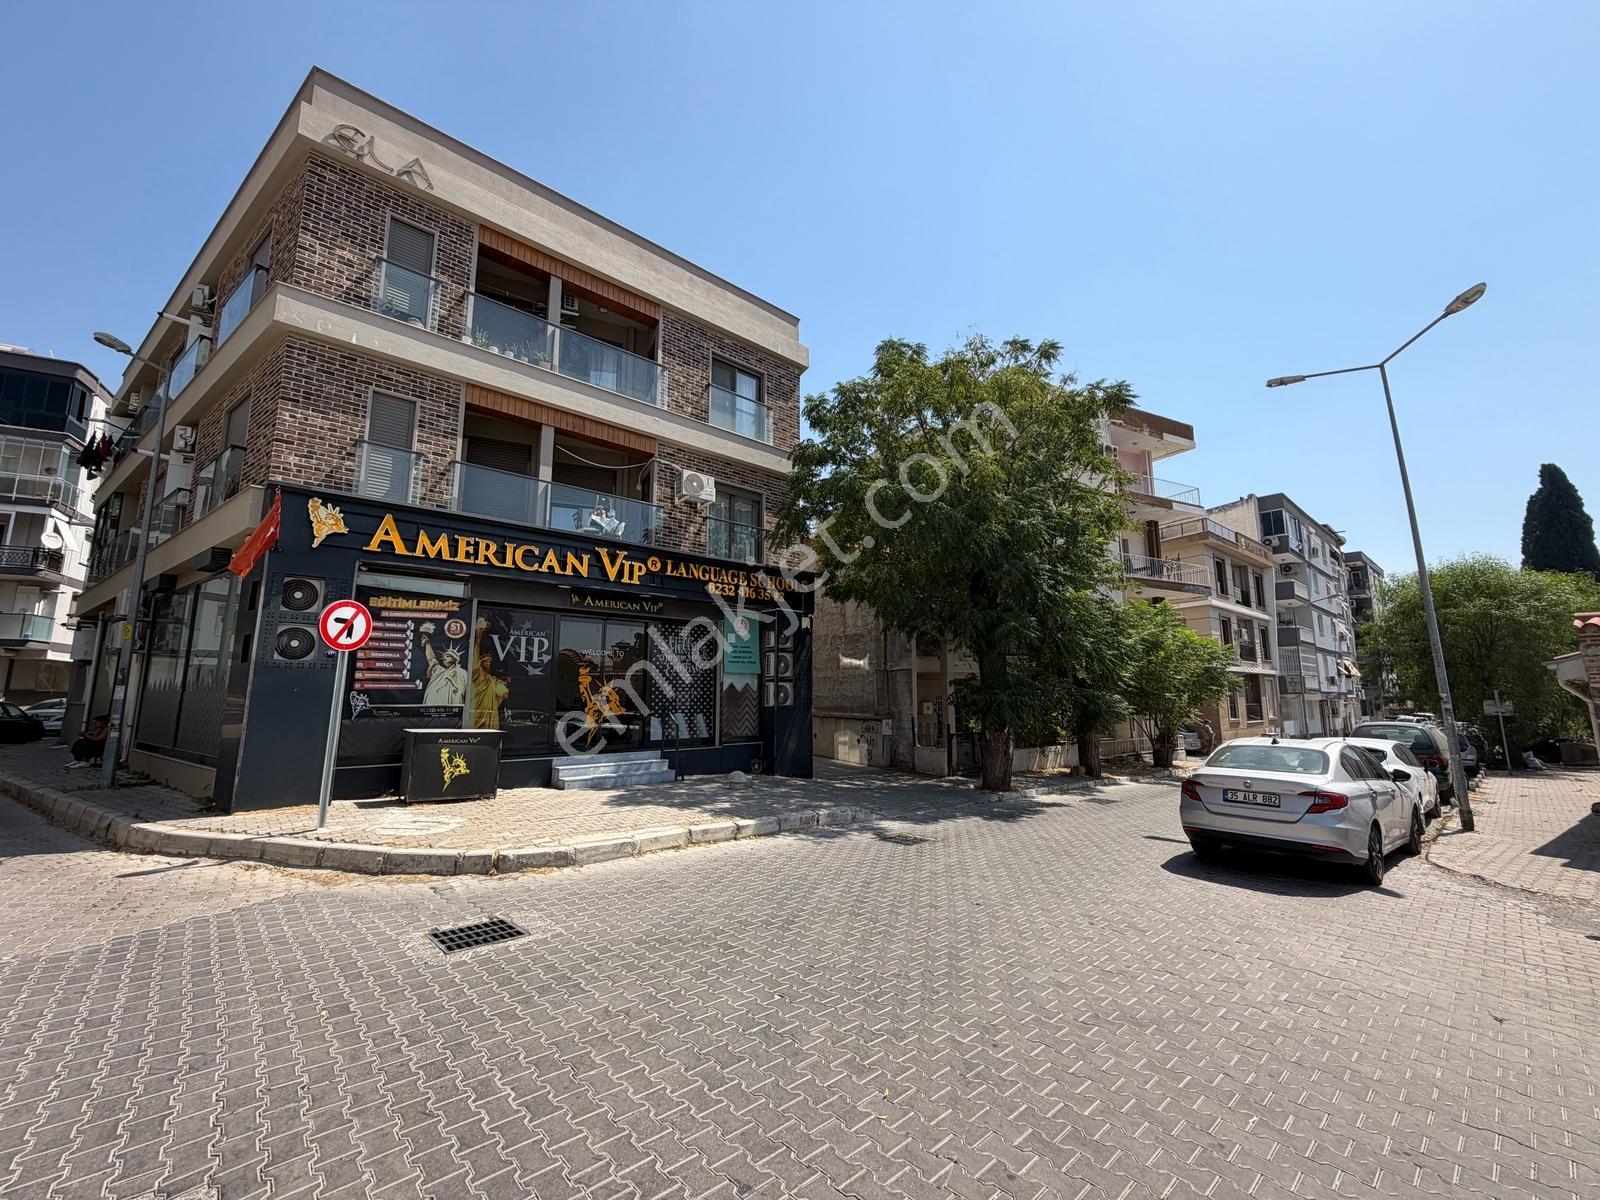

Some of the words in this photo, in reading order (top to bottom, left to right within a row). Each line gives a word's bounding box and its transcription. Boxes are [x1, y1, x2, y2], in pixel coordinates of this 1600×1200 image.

[363, 513, 590, 578] AMERICAN
[665, 559, 748, 586] LANGUAGE
[369, 596, 460, 611] EĞİTİMLERİMİZ
[584, 595, 640, 611] AMERICAN
[450, 622, 461, 631] 51
[509, 629, 546, 637] AMERICAN
[488, 634, 549, 663] VIP
[581, 648, 615, 657] WELCOME
[1229, 791, 1239, 800] 35
[1243, 793, 1258, 802] ALR
[1262, 794, 1278, 805] 882
